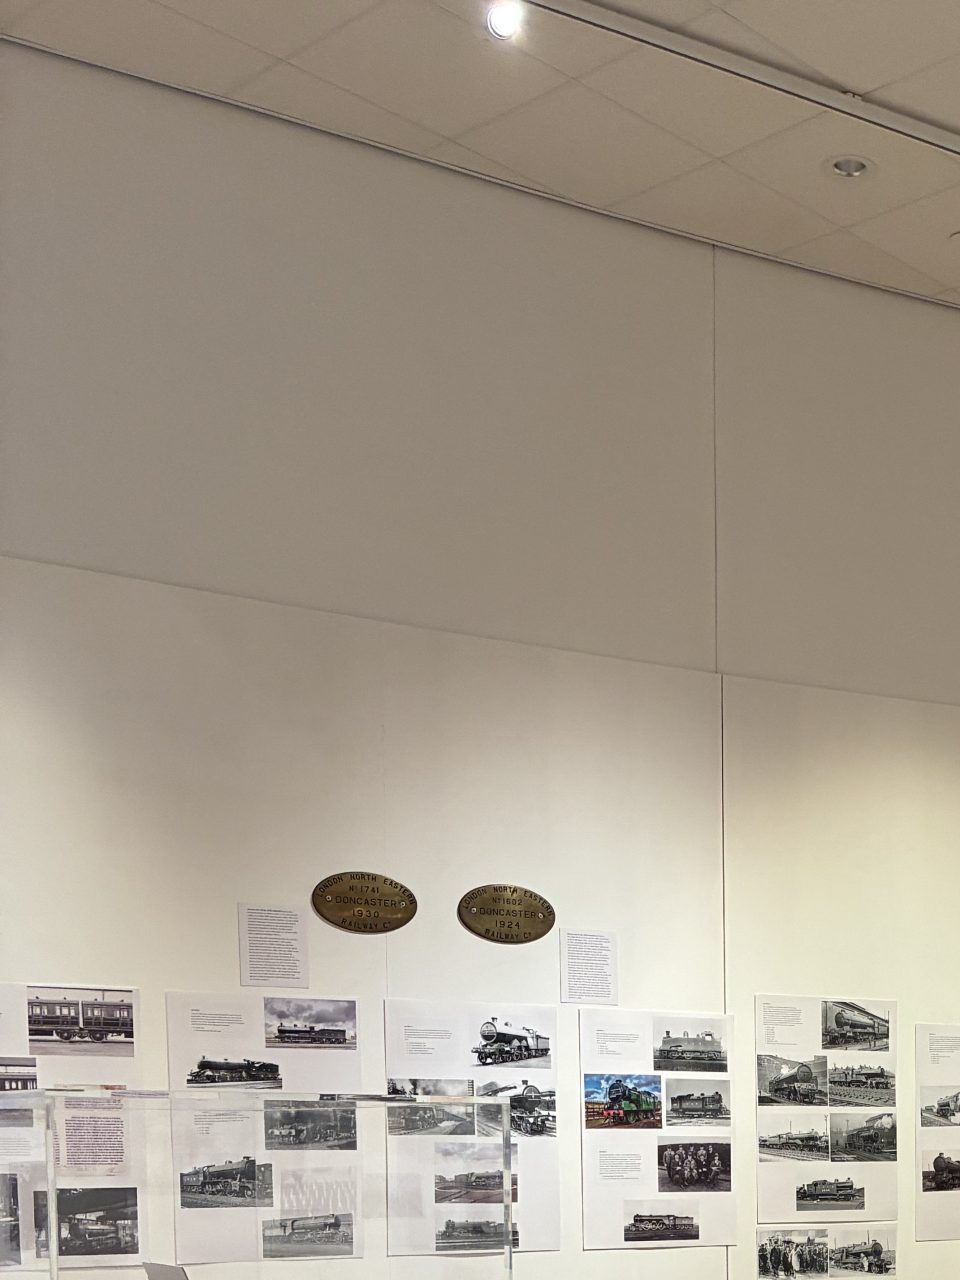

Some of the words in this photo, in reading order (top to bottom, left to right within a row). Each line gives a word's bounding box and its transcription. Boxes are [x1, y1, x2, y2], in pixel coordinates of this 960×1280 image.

[317, 876, 344, 898] LONDON
[350, 873, 377, 882] NORTH
[383, 878, 416, 905] EASTERN
[360, 886, 380, 894] 1741
[335, 895, 397, 908] DONCASTER
[463, 888, 487, 910] LONDON
[493, 885, 518, 894] NORTH
[523, 890, 553, 917] EASTERN
[502, 898, 523, 906] 1602
[352, 909, 380, 918] 1930
[479, 907, 536, 919] DONCASTER
[341, 918, 379, 930] RAILWAY
[495, 920, 520, 930] 1924
[484, 928, 519, 940] RAILWAY
